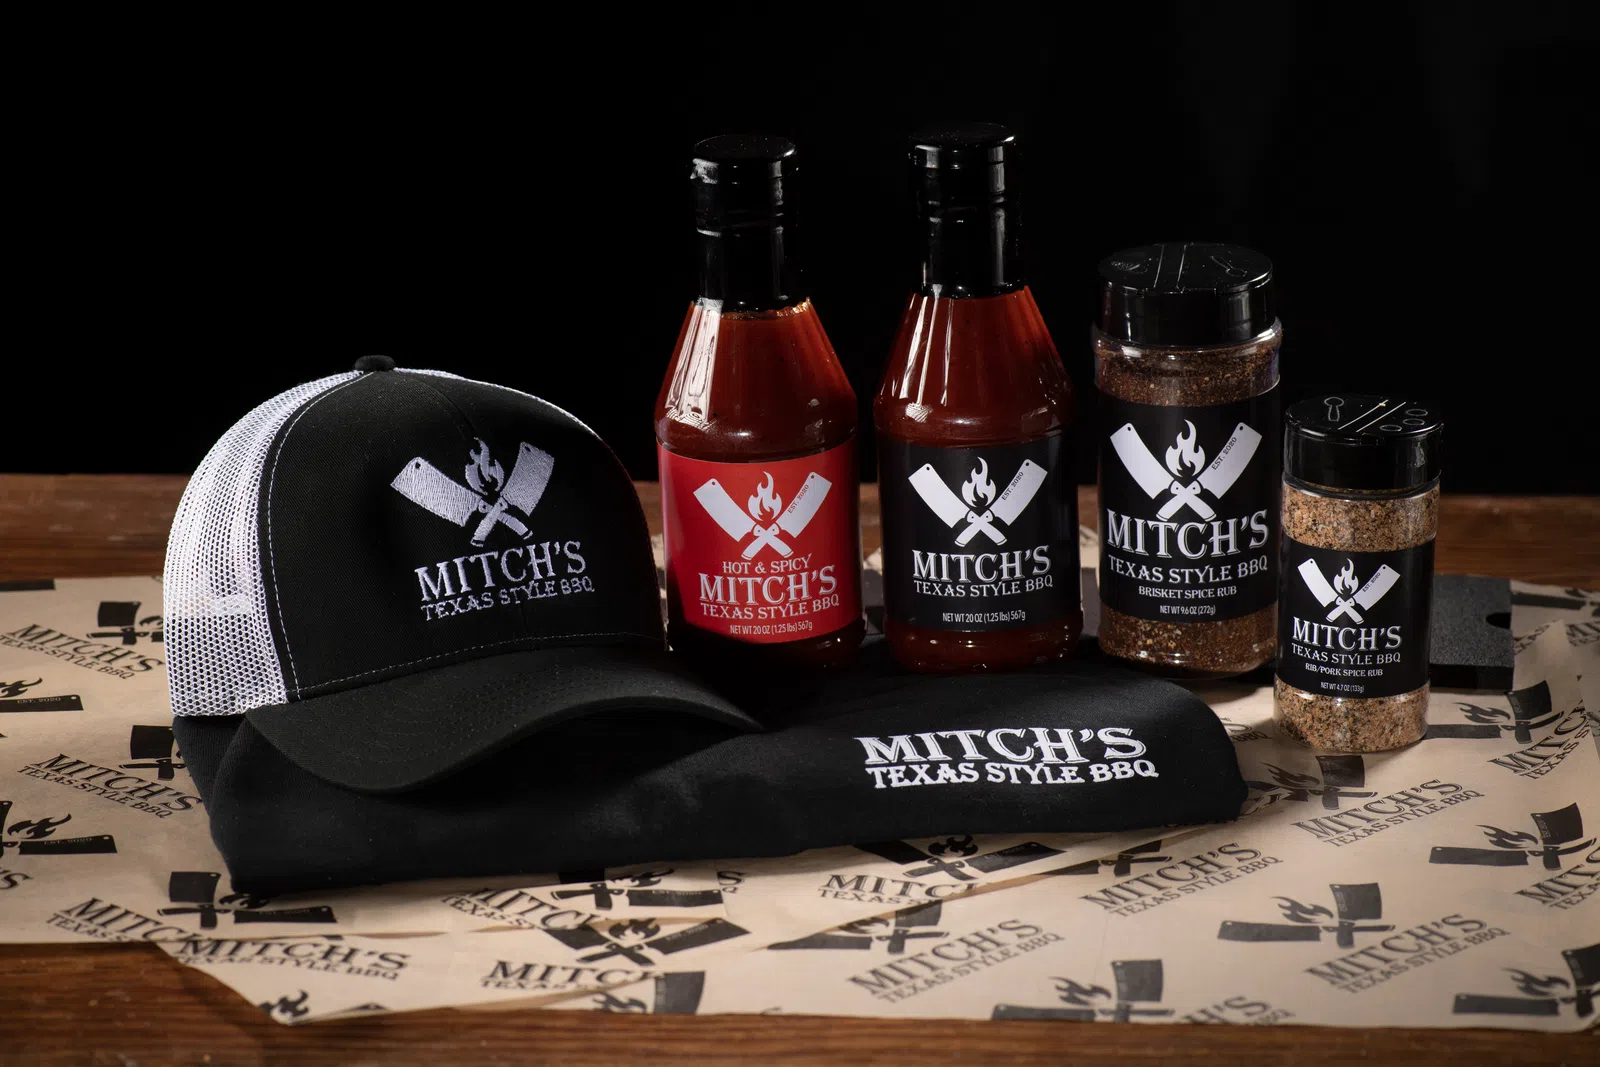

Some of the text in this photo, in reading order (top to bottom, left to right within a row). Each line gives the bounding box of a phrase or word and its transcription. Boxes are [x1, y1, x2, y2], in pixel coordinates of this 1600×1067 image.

[1211, 436, 1237, 471] EST. 2020
[1001, 471, 1024, 501] EST. 2020
[1106, 508, 1269, 560] MITCH'S
[414, 541, 586, 601] MITCH'S
[723, 553, 812, 574] HOT & SPICY
[912, 544, 1051, 583] MITCH'S
[1108, 554, 1268, 584] TEXAS STYLE BBQ
[420, 576, 595, 621] TEXAS STYLE BBQ
[698, 565, 838, 606] MITCH'S
[914, 575, 1053, 598] TEXAS STYLE BBQ
[1138, 585, 1237, 599] BRISKET SPICE RUB
[700, 594, 839, 620] TEXAS STYLE BBQ
[942, 610, 1026, 624] NET WT 20 OZ (1.25 lbs) 567g
[1160, 605, 1170, 614] NET
[1171, 606, 1180, 614] WT
[1190, 606, 1197, 615] OZ
[1197, 605, 1216, 616] (272g)
[730, 621, 812, 635] NET WT 20 OZ (1.25 lbs) 567g
[1292, 616, 1402, 651] MITCH'S
[0, 634, 135, 680] TEXAS STYLE BBQ
[5, 624, 165, 672] MITCH'S
[1292, 643, 1401, 666] TEXAS STYLE BBQ
[1305, 662, 1383, 677] RIB/PORK SPICE RUB
[853, 727, 1146, 765] MITCH'S
[1519, 741, 1580, 779] TEXAS
[17, 765, 174, 819] TEXAS STYLE BBQ
[29, 753, 203, 811] MITCH'S
[865, 759, 1159, 789] TEXAS STYLE BBQ
[1290, 779, 1463, 839] MITCH'S
[1323, 789, 1485, 847] TEXAS STYLE BBQ
[1079, 843, 1261, 910] MITCH'S
[1109, 856, 1284, 917] TEXAS STYLE BBQ
[817, 888, 900, 905] TEXAS
[58, 897, 203, 942] MITC
[174, 938, 412, 971] MITCH'S
[847, 919, 1044, 996] MITCH'S
[877, 932, 1066, 1004] TEXAS STYLE BBQ
[1303, 914, 1488, 985] MITCH'S
[1338, 927, 1510, 994] TEXAS STYLE BBQ
